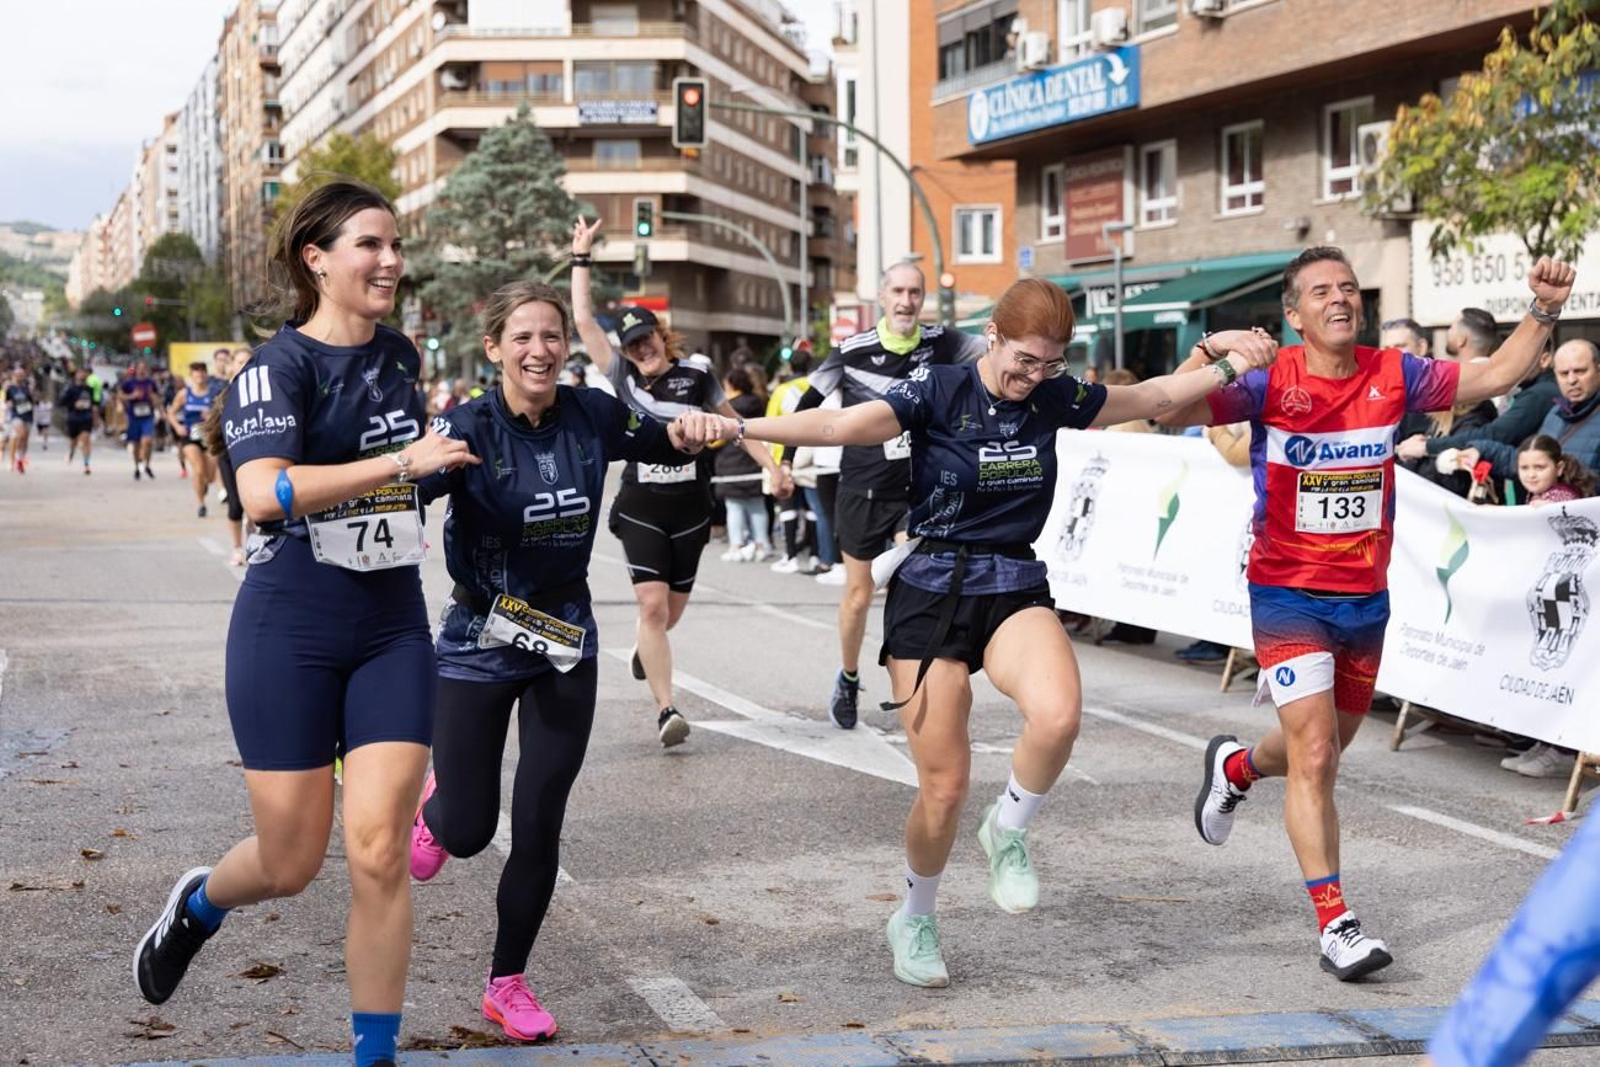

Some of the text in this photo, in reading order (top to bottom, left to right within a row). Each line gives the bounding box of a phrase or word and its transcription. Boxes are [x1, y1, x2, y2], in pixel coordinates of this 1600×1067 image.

[1045, 61, 1107, 103] DENTAL
[1472, 253, 1506, 283] 650
[225, 408, 296, 444] Rotalaya
[360, 409, 420, 451] 25
[979, 440, 1037, 462] 25
[979, 459, 1040, 471] CARRERA
[979, 467, 1043, 480] POPULAR
[940, 470, 958, 486] IES
[1302, 474, 1322, 486] XXV
[375, 494, 413, 503] caminata
[376, 487, 412, 496] POPULAR
[523, 488, 591, 523] 25
[1318, 495, 1366, 519] 133
[347, 518, 394, 552] 74
[482, 535, 501, 550] IES
[500, 596, 524, 613] XXV
[1434, 631, 1474, 653] Municipal
[1475, 644, 1486, 656] de
[1400, 642, 1468, 671] Deportes de Jaén
[1500, 674, 1576, 705] CIUDAD DE JAÉN
